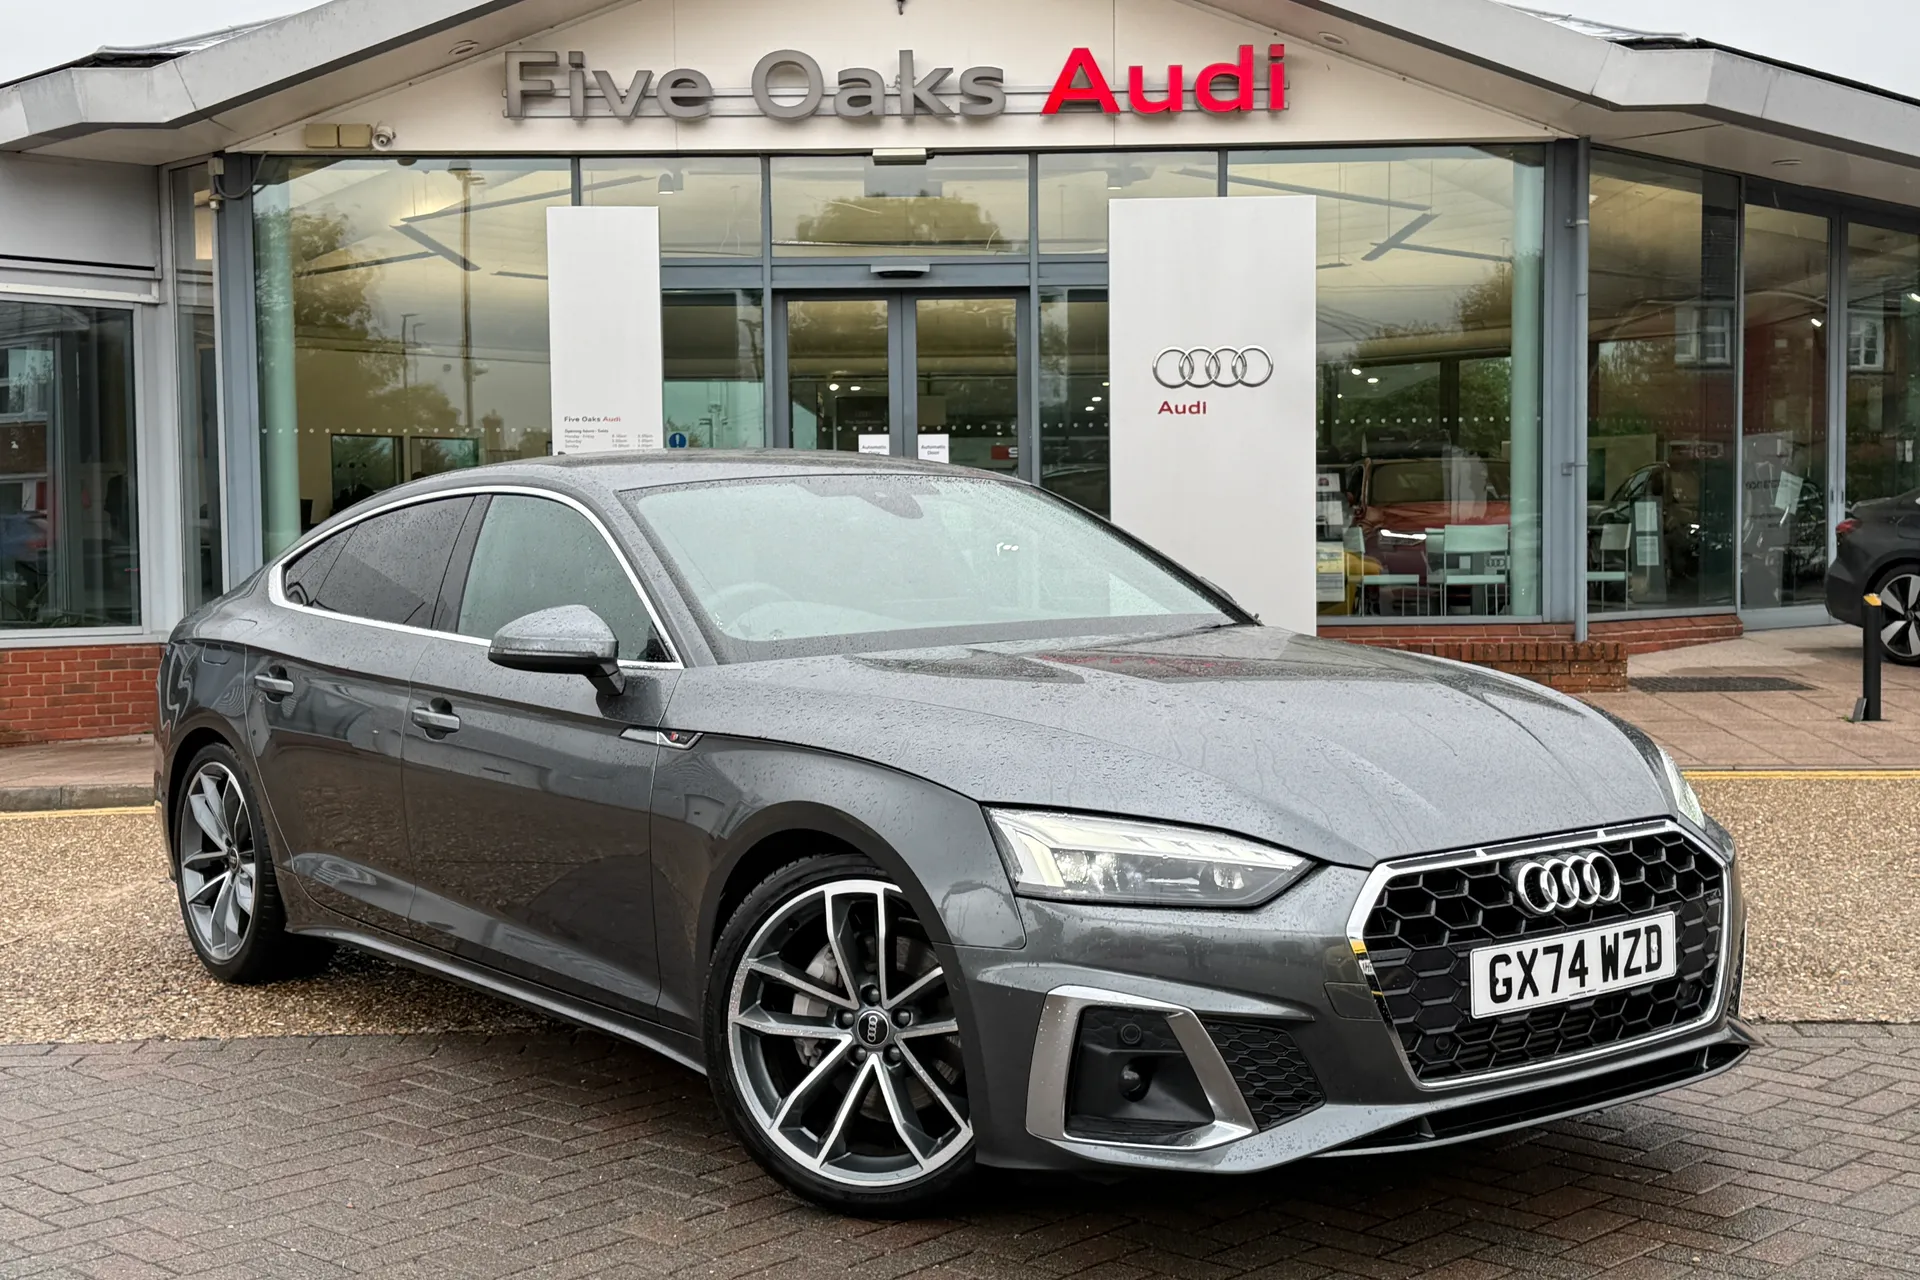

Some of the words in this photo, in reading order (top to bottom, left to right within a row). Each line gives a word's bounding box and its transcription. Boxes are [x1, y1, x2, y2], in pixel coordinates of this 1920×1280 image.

[504, 51, 714, 120] Five
[751, 49, 1007, 119] Oaks
[1040, 44, 1285, 115] Audi
[1157, 400, 1207, 415] Audi
[1489, 939, 1589, 1004] GX74
[1599, 923, 1663, 983] WZD
